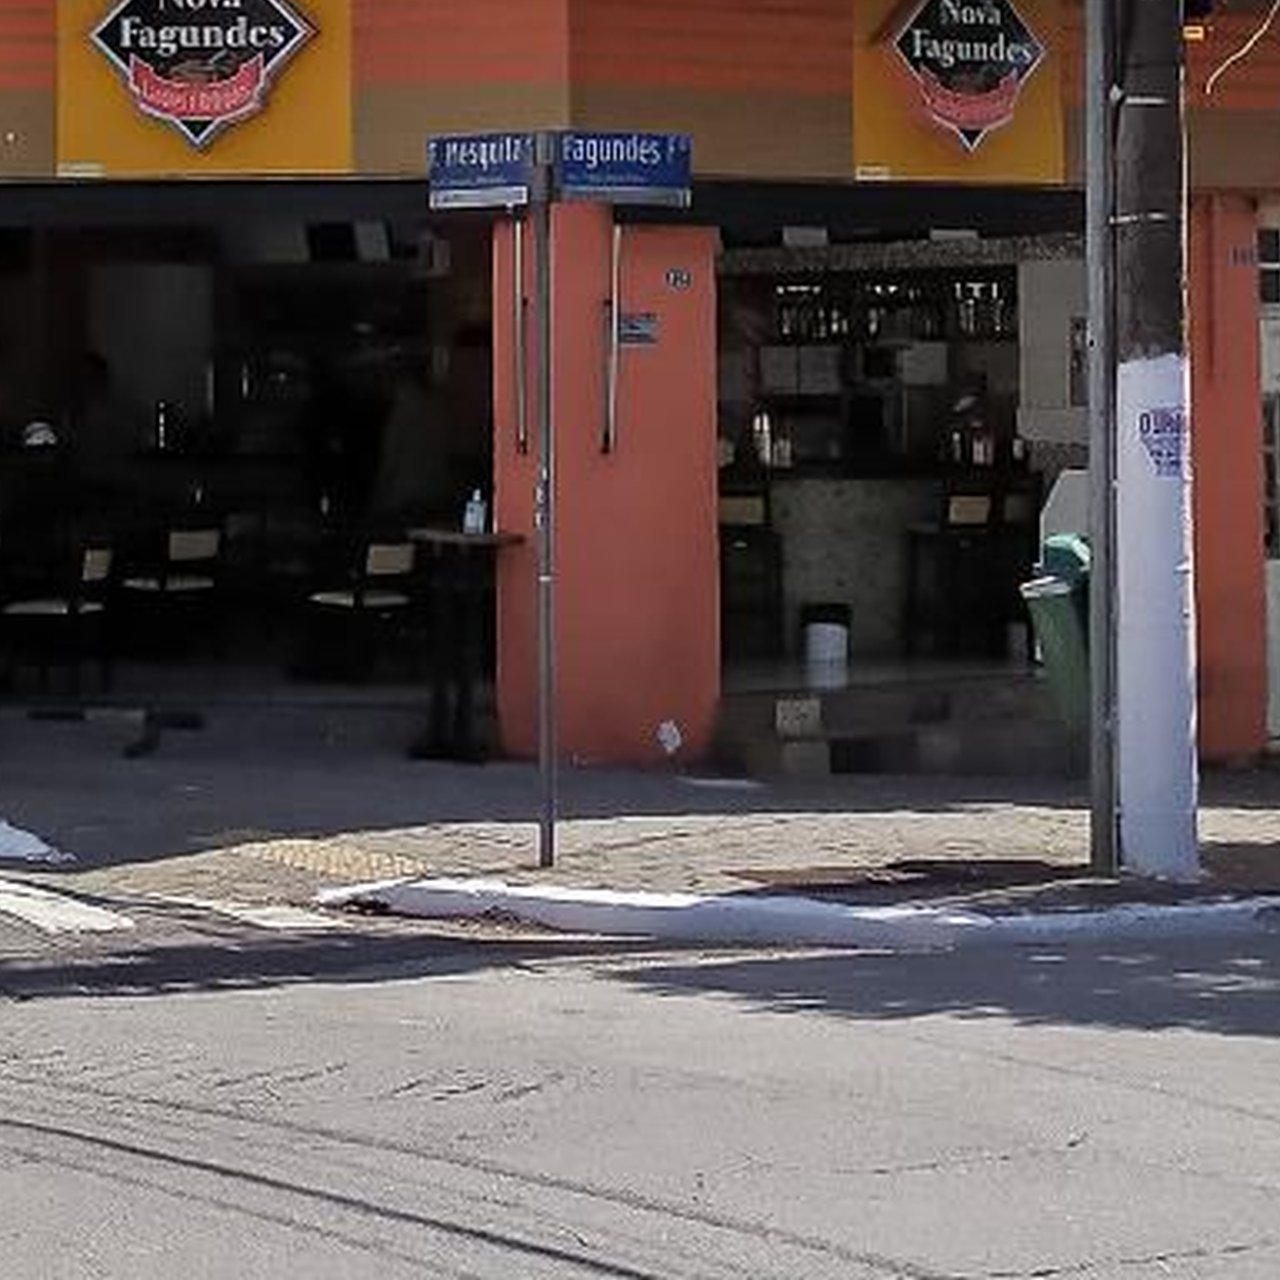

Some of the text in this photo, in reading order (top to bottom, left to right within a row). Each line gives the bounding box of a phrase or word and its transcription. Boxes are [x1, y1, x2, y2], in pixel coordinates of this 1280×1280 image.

[120, 15, 286, 56] Fagundes
[911, 28, 1033, 68] Fagundes
[562, 134, 661, 169] Fagundes
